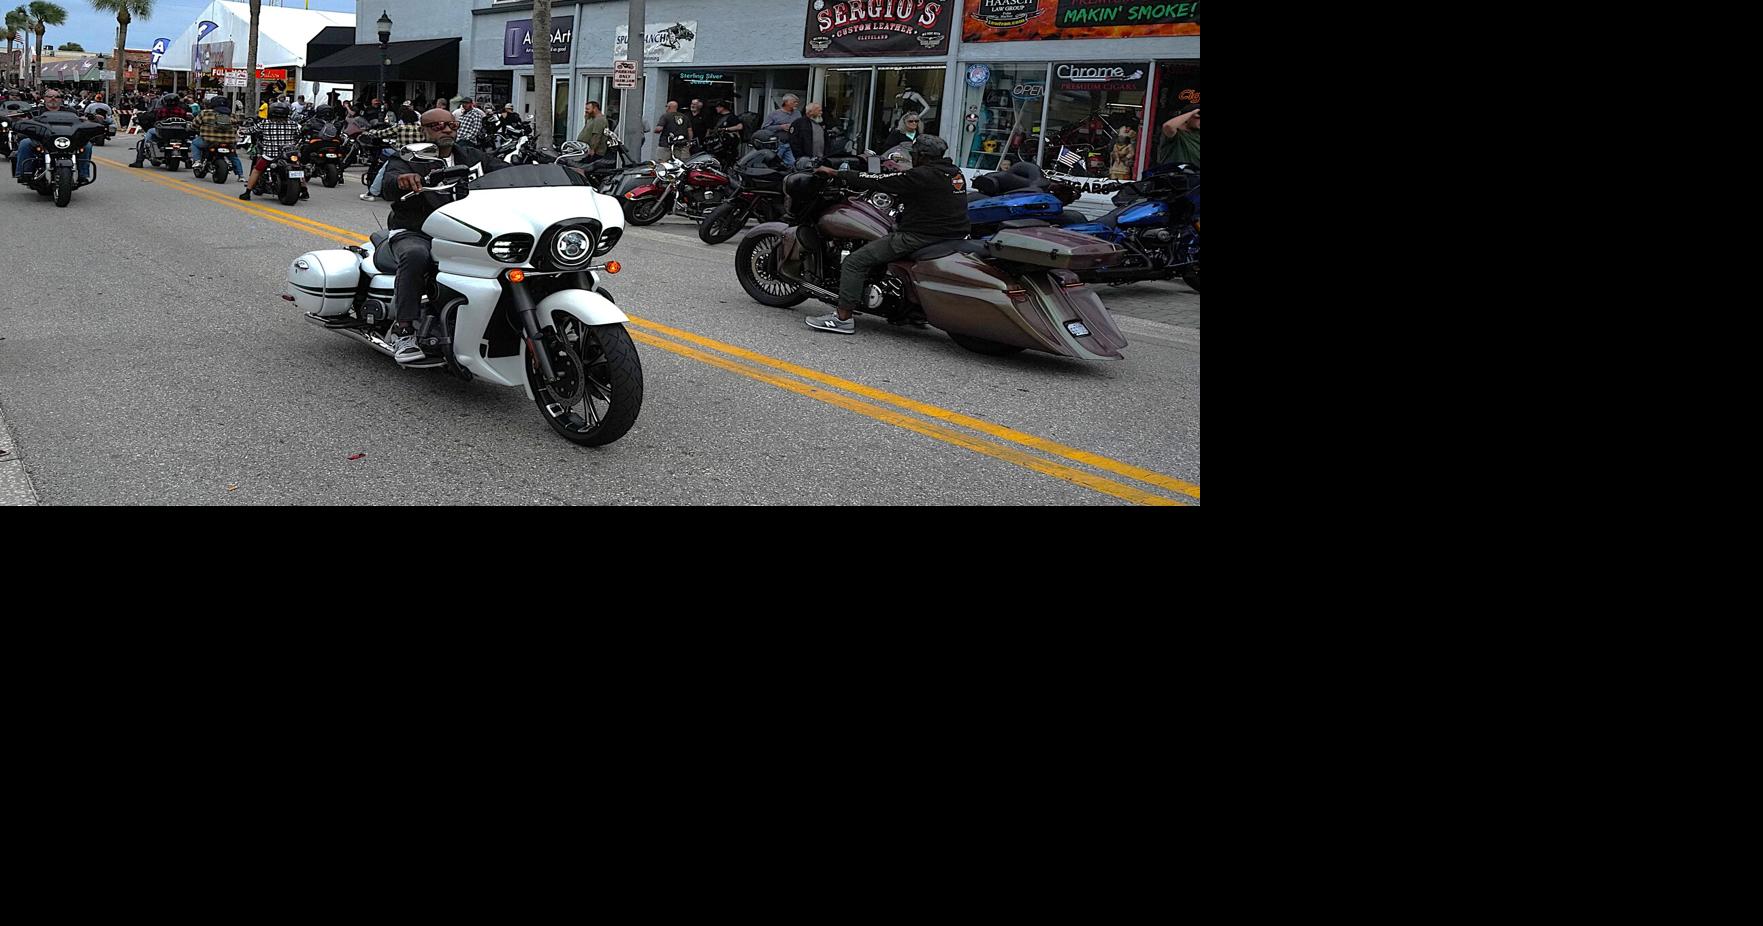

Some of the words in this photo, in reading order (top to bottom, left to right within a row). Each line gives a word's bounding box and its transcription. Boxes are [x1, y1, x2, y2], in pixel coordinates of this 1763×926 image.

[816, 0, 942, 32] SERGIO'S
[1063, 5, 1122, 23] MAKIN'
[1127, 2, 1197, 20] SMOKE!
[836, 23, 871, 37] CUSTOM
[872, 22, 911, 34] LEATHER
[679, 72, 704, 80] Sterling
[1056, 63, 1125, 82] Chrome
[1013, 85, 1046, 97] OPEN
